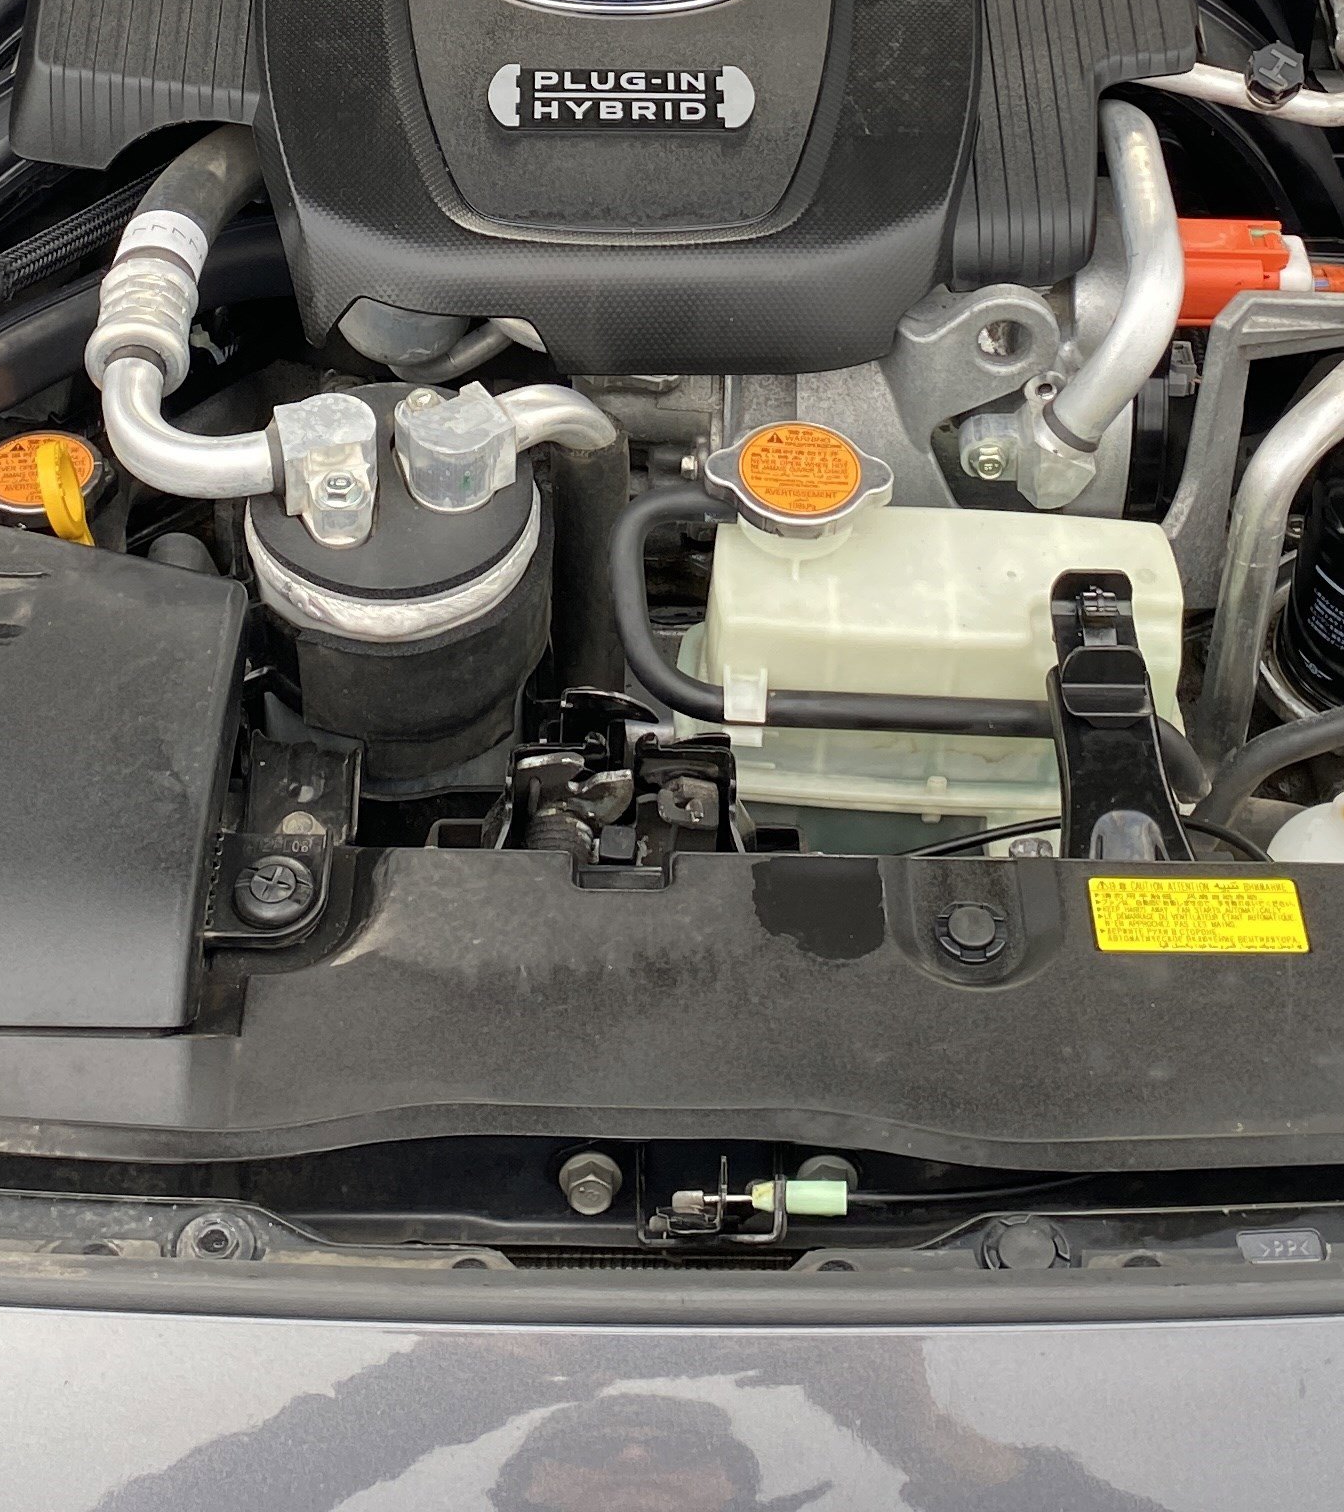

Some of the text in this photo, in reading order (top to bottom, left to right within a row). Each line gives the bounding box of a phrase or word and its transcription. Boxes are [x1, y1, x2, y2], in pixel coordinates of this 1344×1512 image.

[534, 71, 706, 90] PLUG-IN
[534, 100, 707, 120] HYBRID
[1131, 881, 1164, 891] CAUTION
[1168, 881, 1210, 892] ATTENTION
